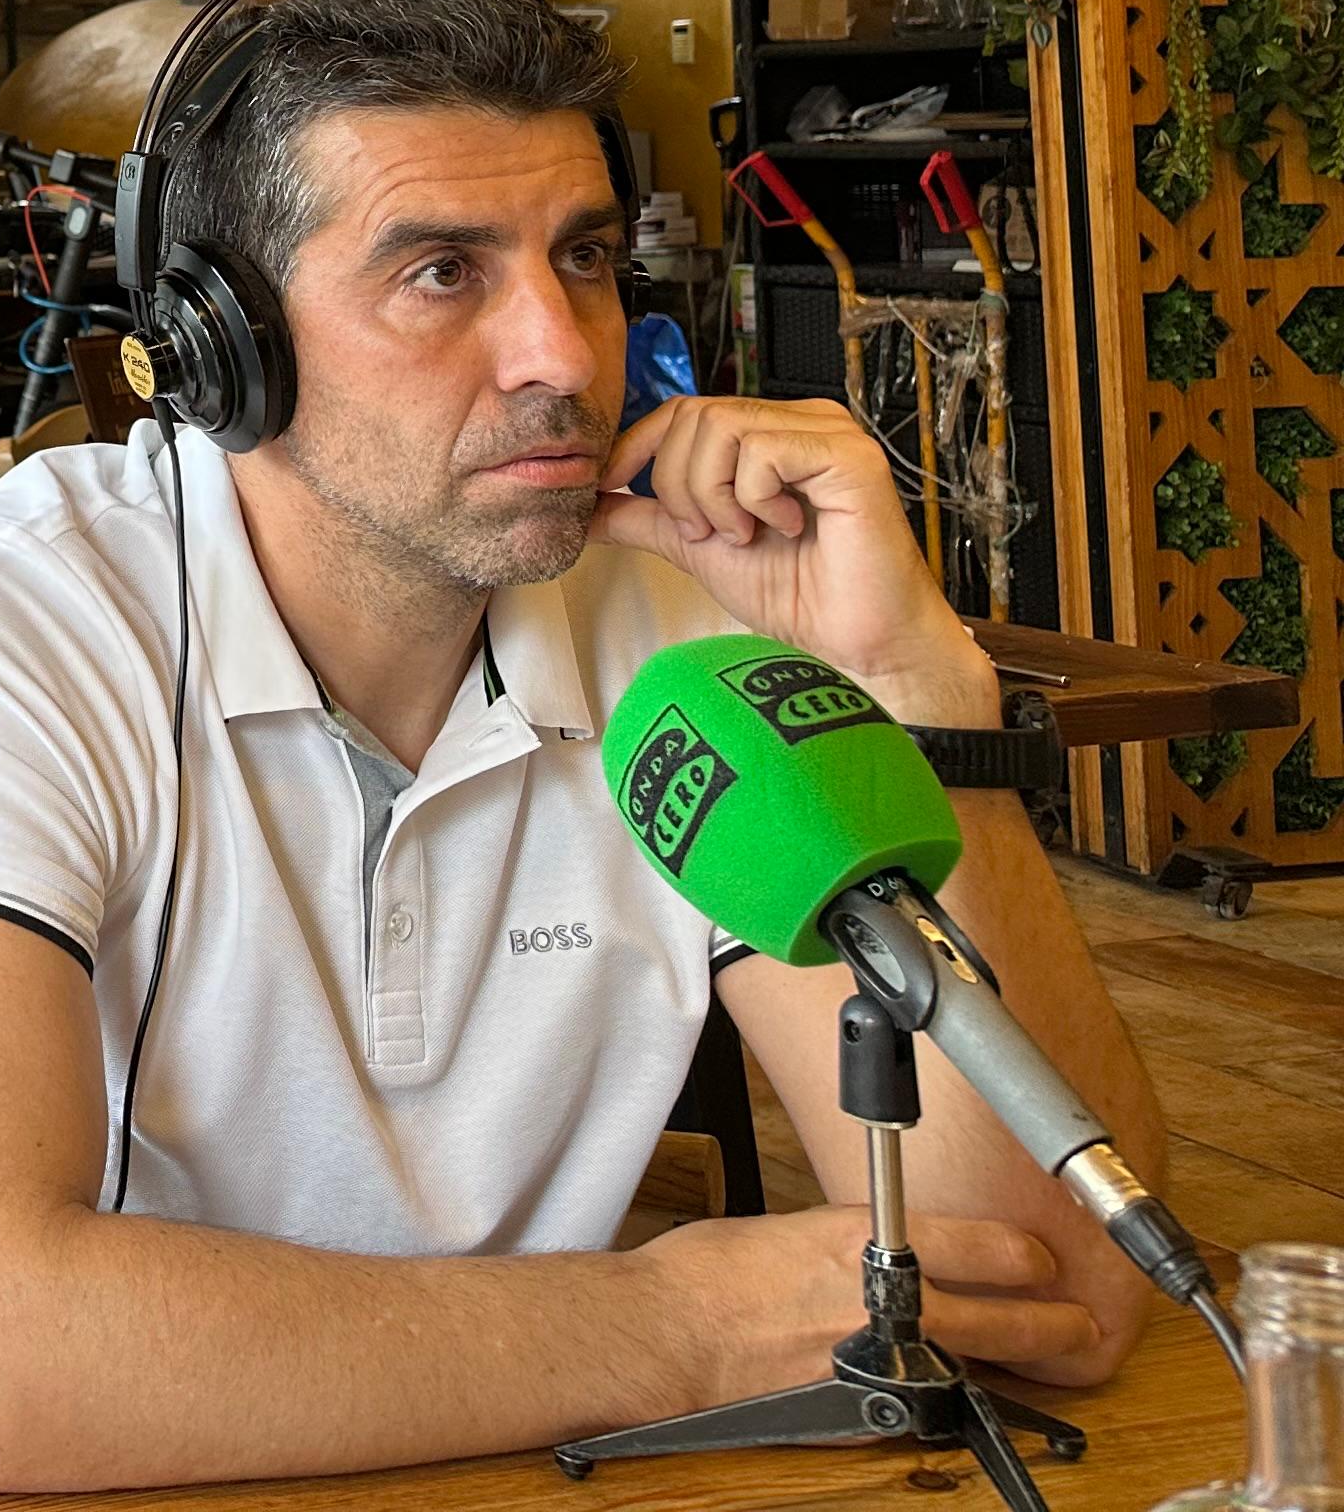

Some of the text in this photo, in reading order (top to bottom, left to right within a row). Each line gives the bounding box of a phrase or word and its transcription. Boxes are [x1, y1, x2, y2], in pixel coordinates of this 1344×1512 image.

[131, 356, 150, 373] 240
[757, 666, 837, 691] ONDA
[787, 686, 864, 720] CERO
[632, 737, 679, 817] ONDA
[654, 764, 706, 845] CERO
[509, 922, 593, 955] BOSS
